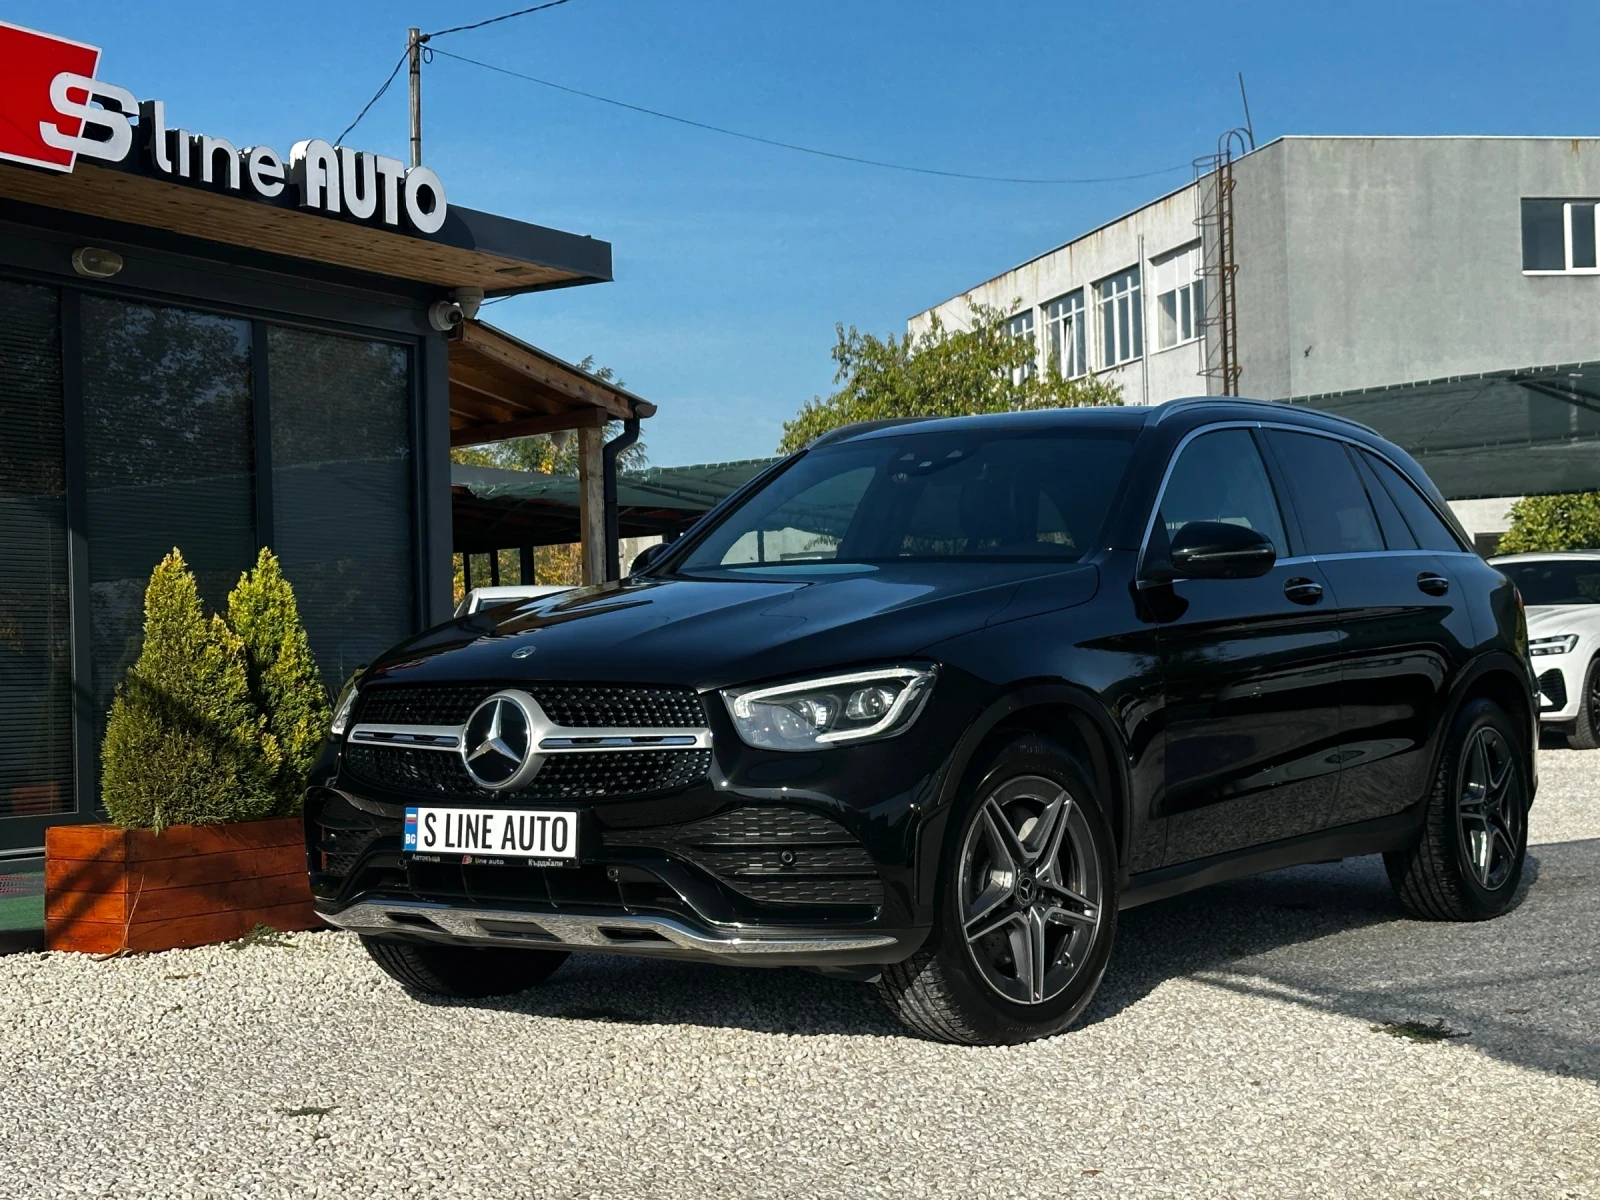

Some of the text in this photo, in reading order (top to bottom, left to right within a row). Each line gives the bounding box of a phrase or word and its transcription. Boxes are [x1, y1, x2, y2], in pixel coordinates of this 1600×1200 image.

[39, 71, 447, 234] S line AUTO
[405, 834, 416, 844] BG
[424, 812, 568, 852] S LINE AUTO
[528, 858, 563, 867] Кърджали
